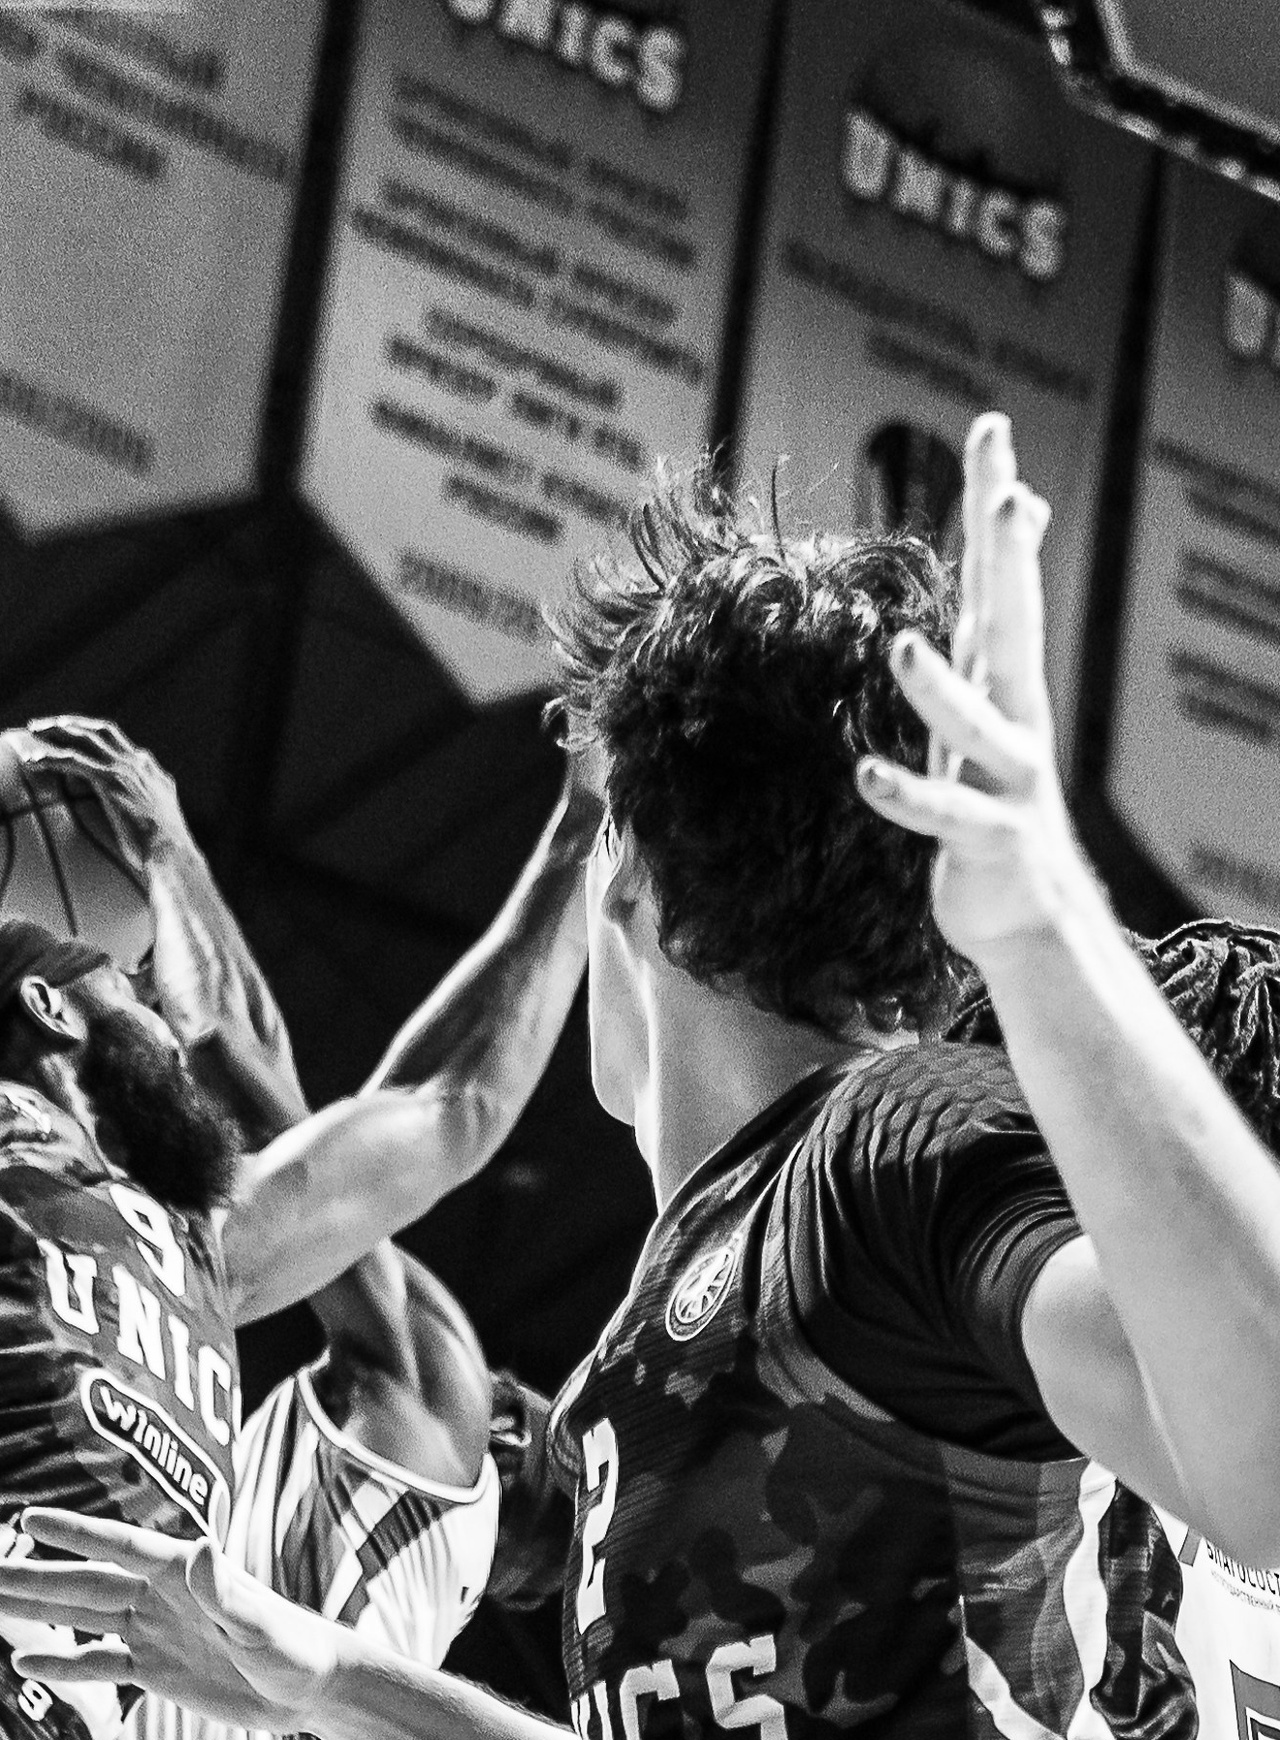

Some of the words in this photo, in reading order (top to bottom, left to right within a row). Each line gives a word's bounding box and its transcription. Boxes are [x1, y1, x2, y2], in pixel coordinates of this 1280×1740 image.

[446, 0, 686, 111] NICS
[109, 1184, 186, 1297] 9
[37, 1238, 241, 1447] UNIC
[98, 1385, 209, 1506] winline
